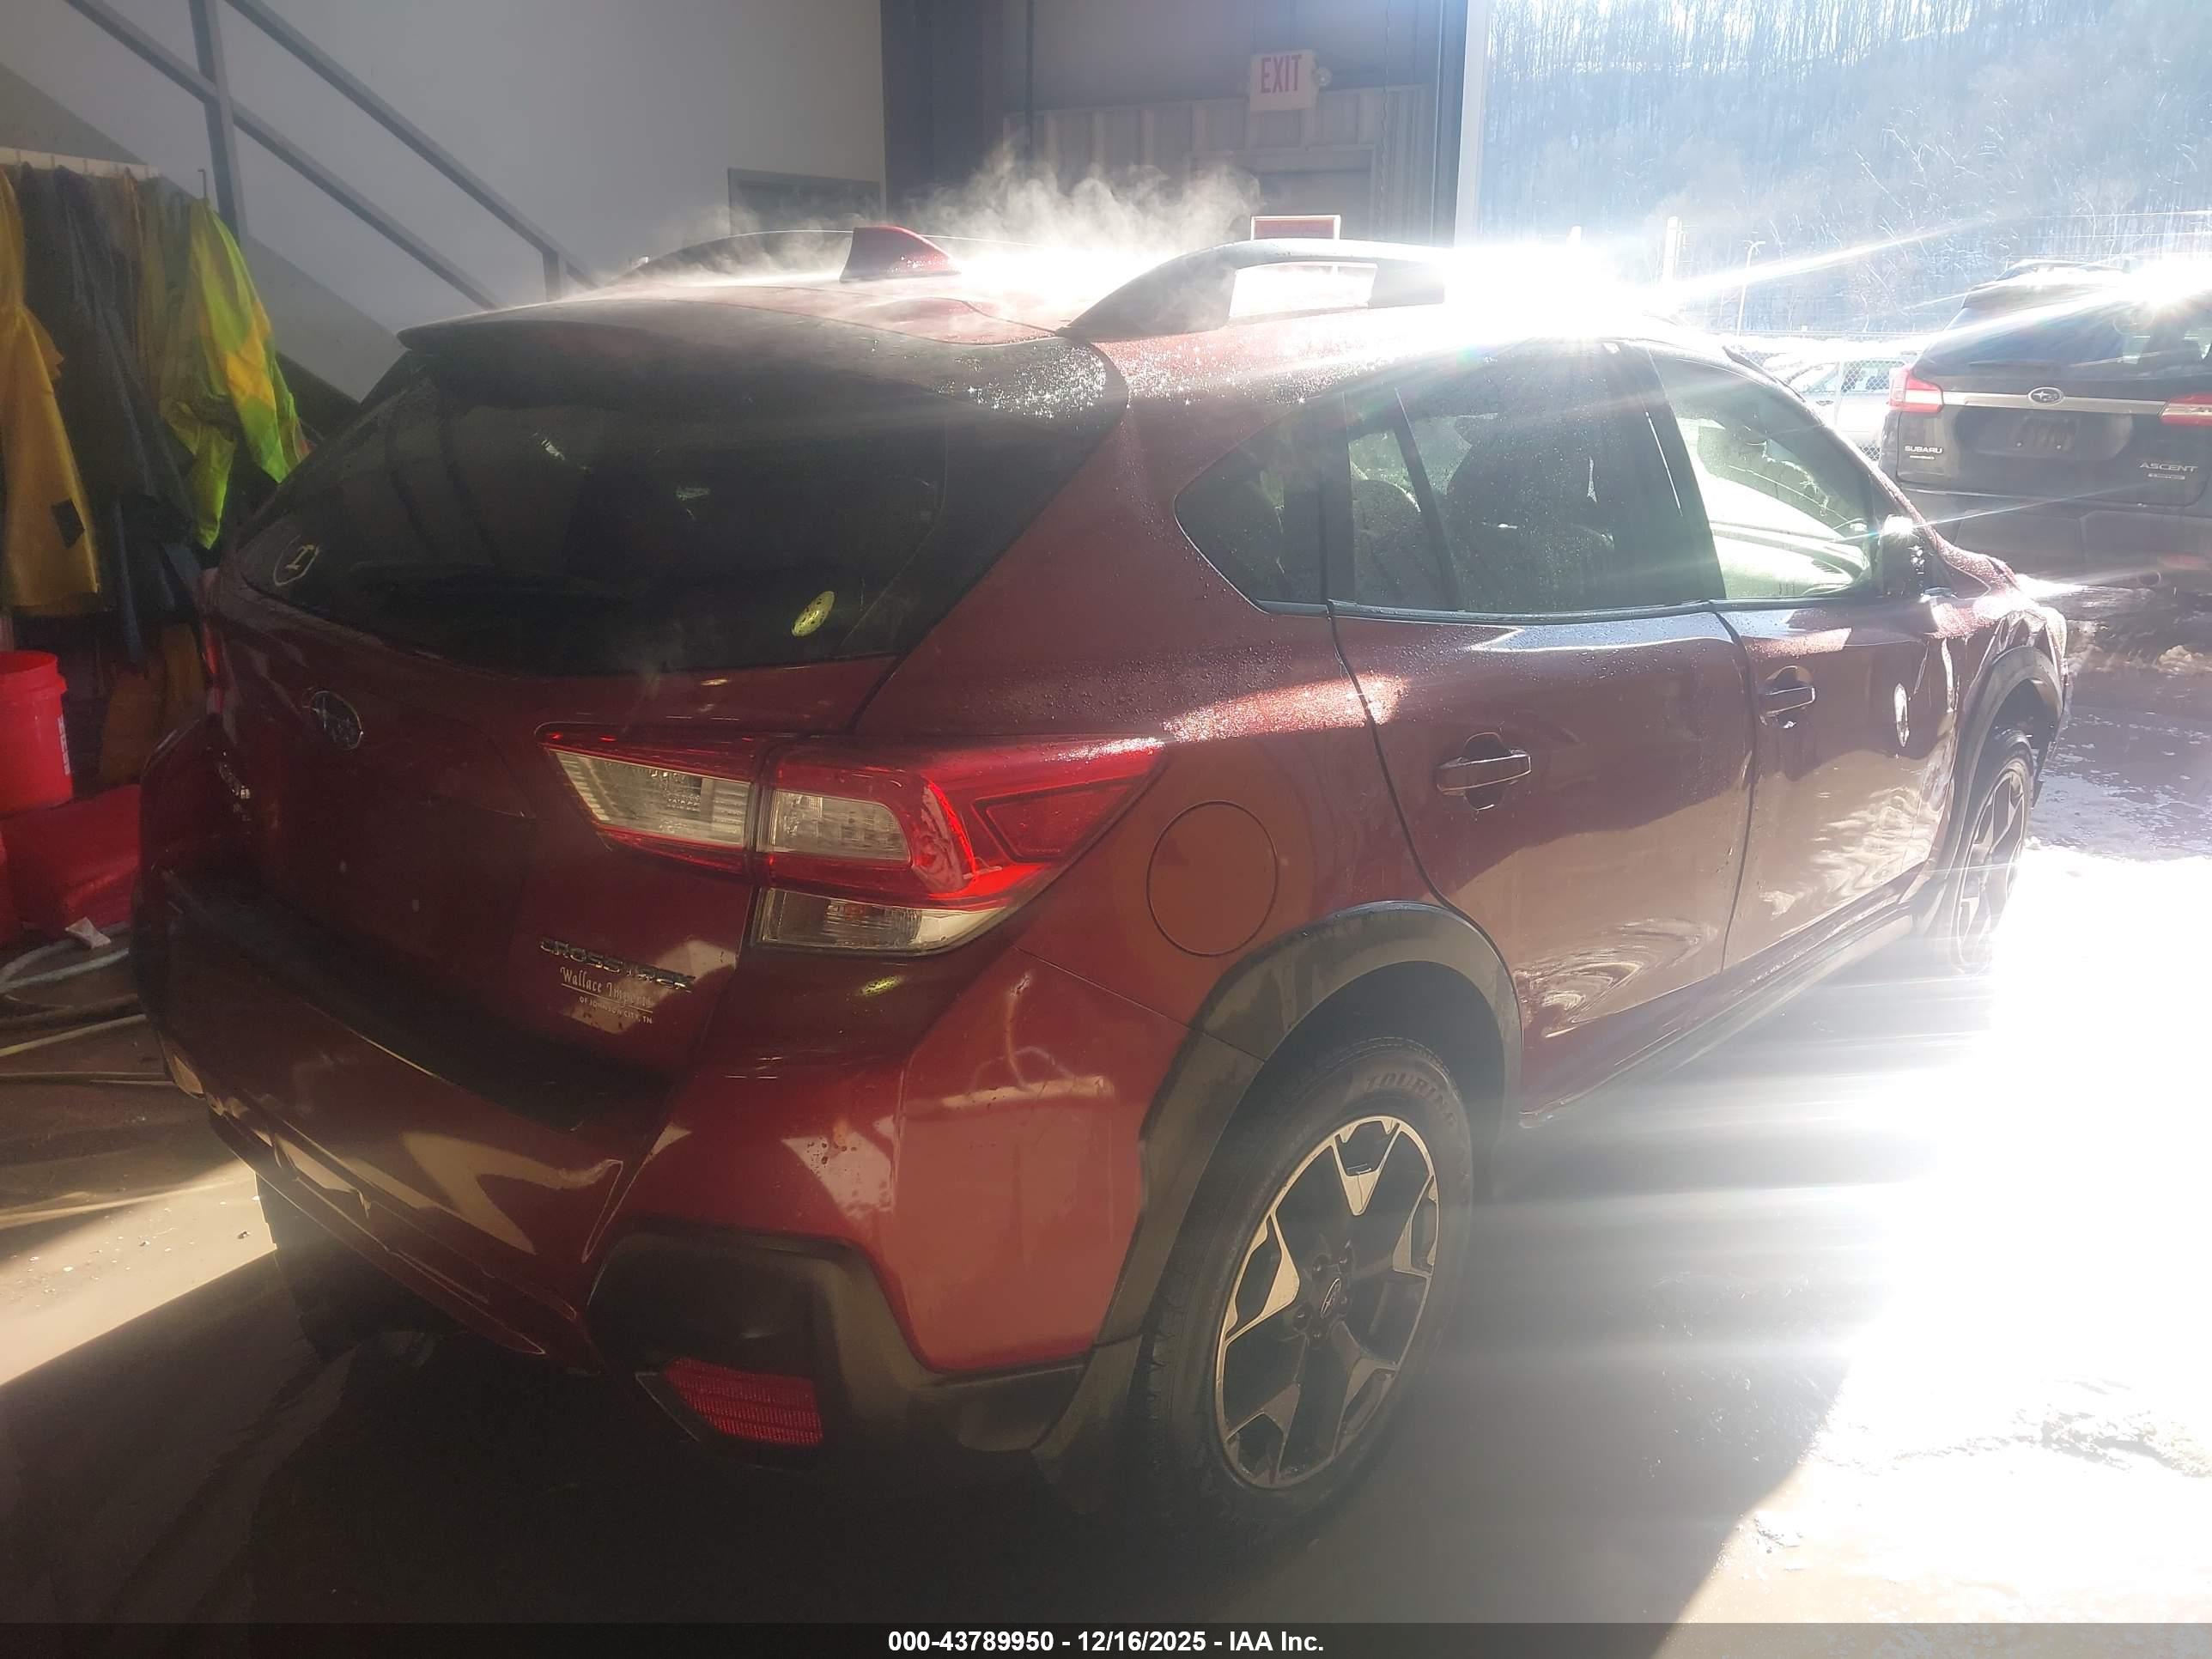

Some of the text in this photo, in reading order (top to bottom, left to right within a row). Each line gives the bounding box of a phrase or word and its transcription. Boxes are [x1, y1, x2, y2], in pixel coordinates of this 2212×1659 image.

[1261, 53, 1303, 94] EXIT
[1904, 445, 1944, 454] SUBARU
[2139, 461, 2199, 472] ASCENT
[560, 966, 653, 1008] Wallace Imports
[578, 995, 588, 1004] OF
[589, 998, 622, 1015] JOHNSON
[642, 1016, 653, 1024] TN
